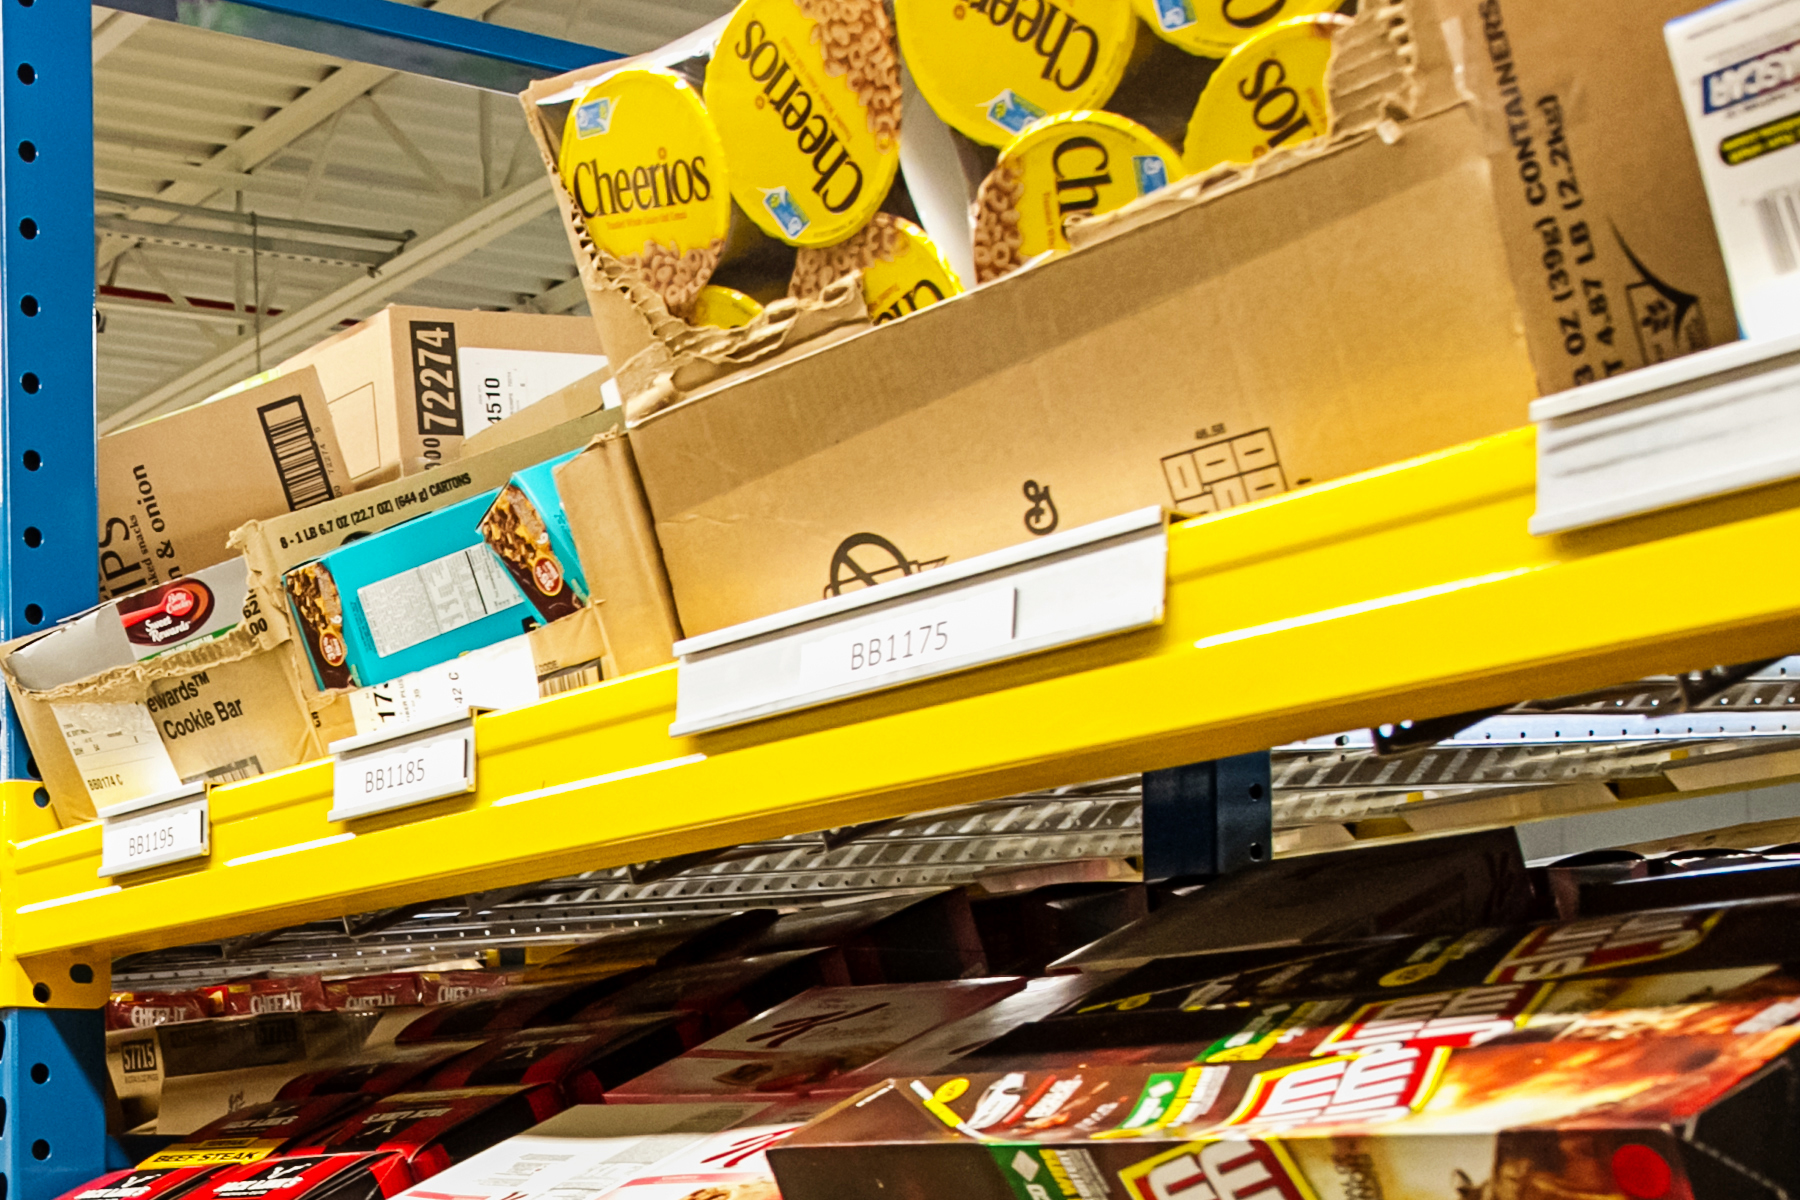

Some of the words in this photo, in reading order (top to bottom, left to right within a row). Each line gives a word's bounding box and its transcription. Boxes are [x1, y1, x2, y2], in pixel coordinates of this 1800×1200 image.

[735, 20, 864, 214] Cheerios
[574, 155, 711, 220] Cheerios
[416, 327, 457, 430] 72274
[132, 464, 166, 533] onion
[429, 472, 472, 496] CARTONS
[129, 514, 149, 557] snacks
[156, 540, 175, 559] &
[850, 620, 949, 671] BB1175
[163, 710, 216, 740] Cookie
[213, 699, 244, 723] Bar
[365, 759, 426, 793] BB1185
[128, 826, 175, 857] BB1195
[122, 1043, 156, 1072] 57715
[153, 1152, 198, 1164] BEEF
[199, 1151, 260, 1162] STEAK
